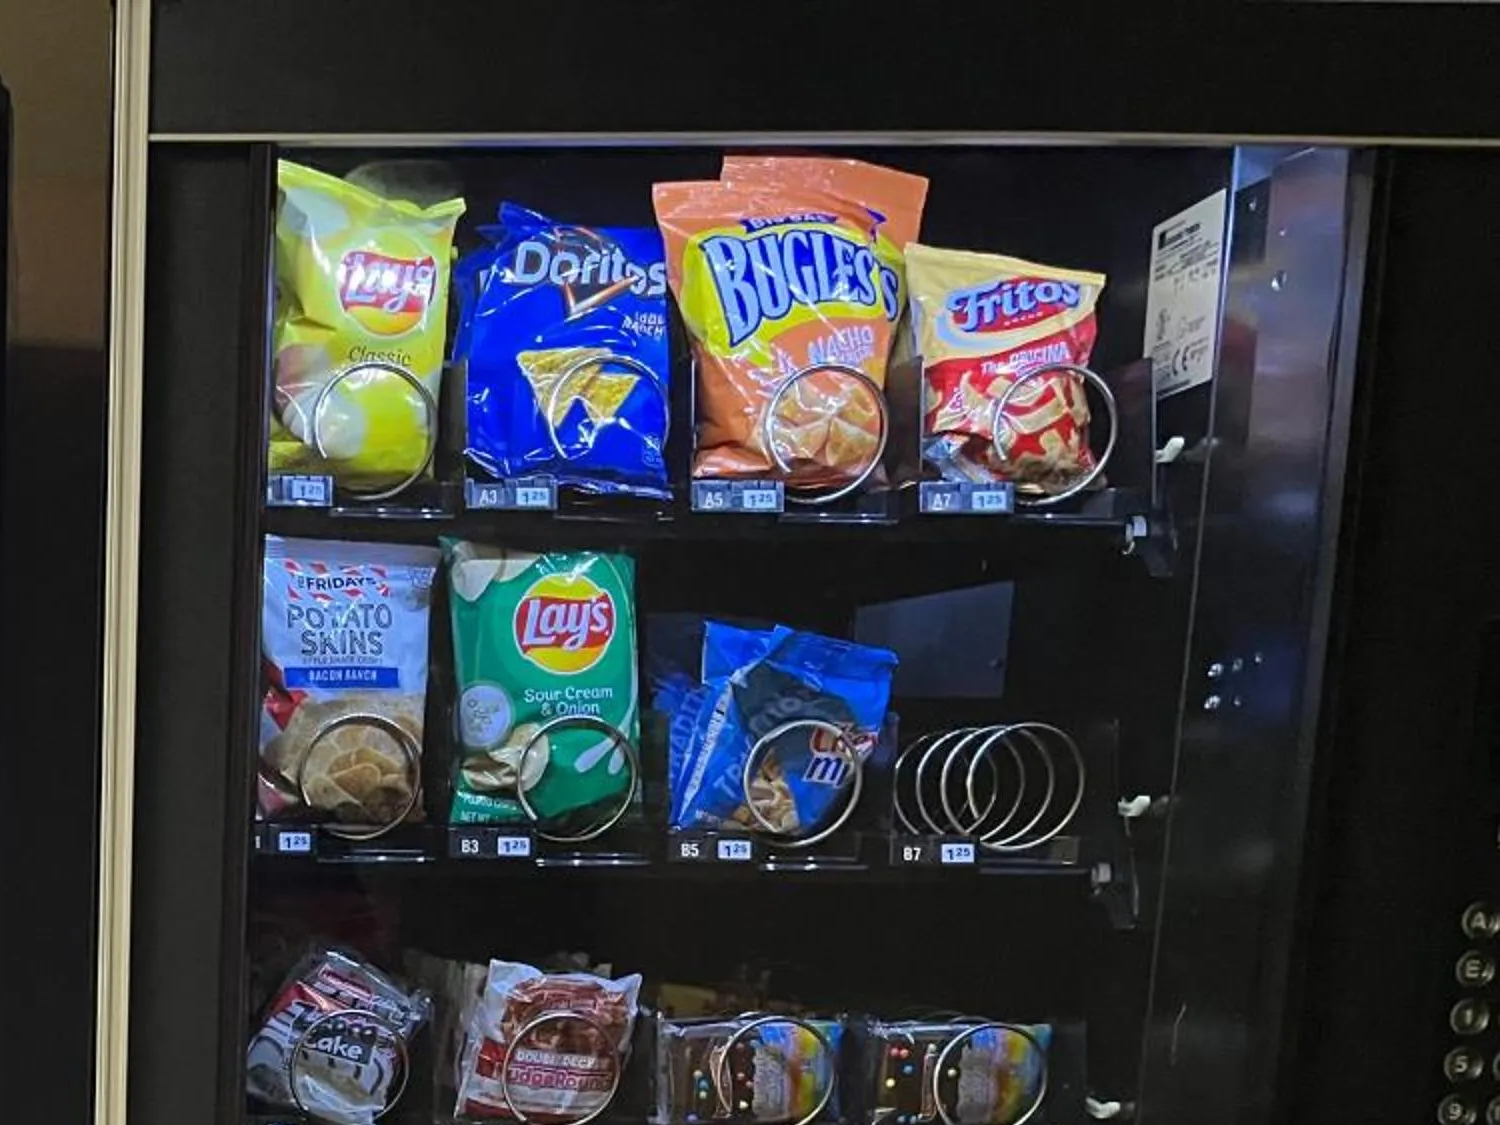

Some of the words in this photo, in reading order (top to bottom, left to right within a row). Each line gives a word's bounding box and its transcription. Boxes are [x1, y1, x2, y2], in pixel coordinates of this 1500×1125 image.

[515, 240, 667, 296] Doritos
[698, 230, 876, 347] BUGLES
[948, 281, 1081, 332] Fritos
[349, 346, 412, 366] Classic
[479, 490, 498, 503] A3
[705, 491, 723, 507] A5
[933, 492, 952, 508] A7
[287, 603, 393, 629] POTATO
[524, 594, 610, 651] Lay's
[301, 630, 384, 656] SKINS
[524, 688, 564, 703] Sour
[565, 686, 613, 700] Cream
[556, 701, 600, 715] Onion
[461, 839, 479, 853] B3
[681, 844, 699, 857] B5
[903, 846, 922, 860] B7
[1470, 911, 1487, 929] A
[1465, 959, 1481, 978] E
[1455, 1055, 1468, 1072] 5
[1449, 1103, 1462, 1120] 9
